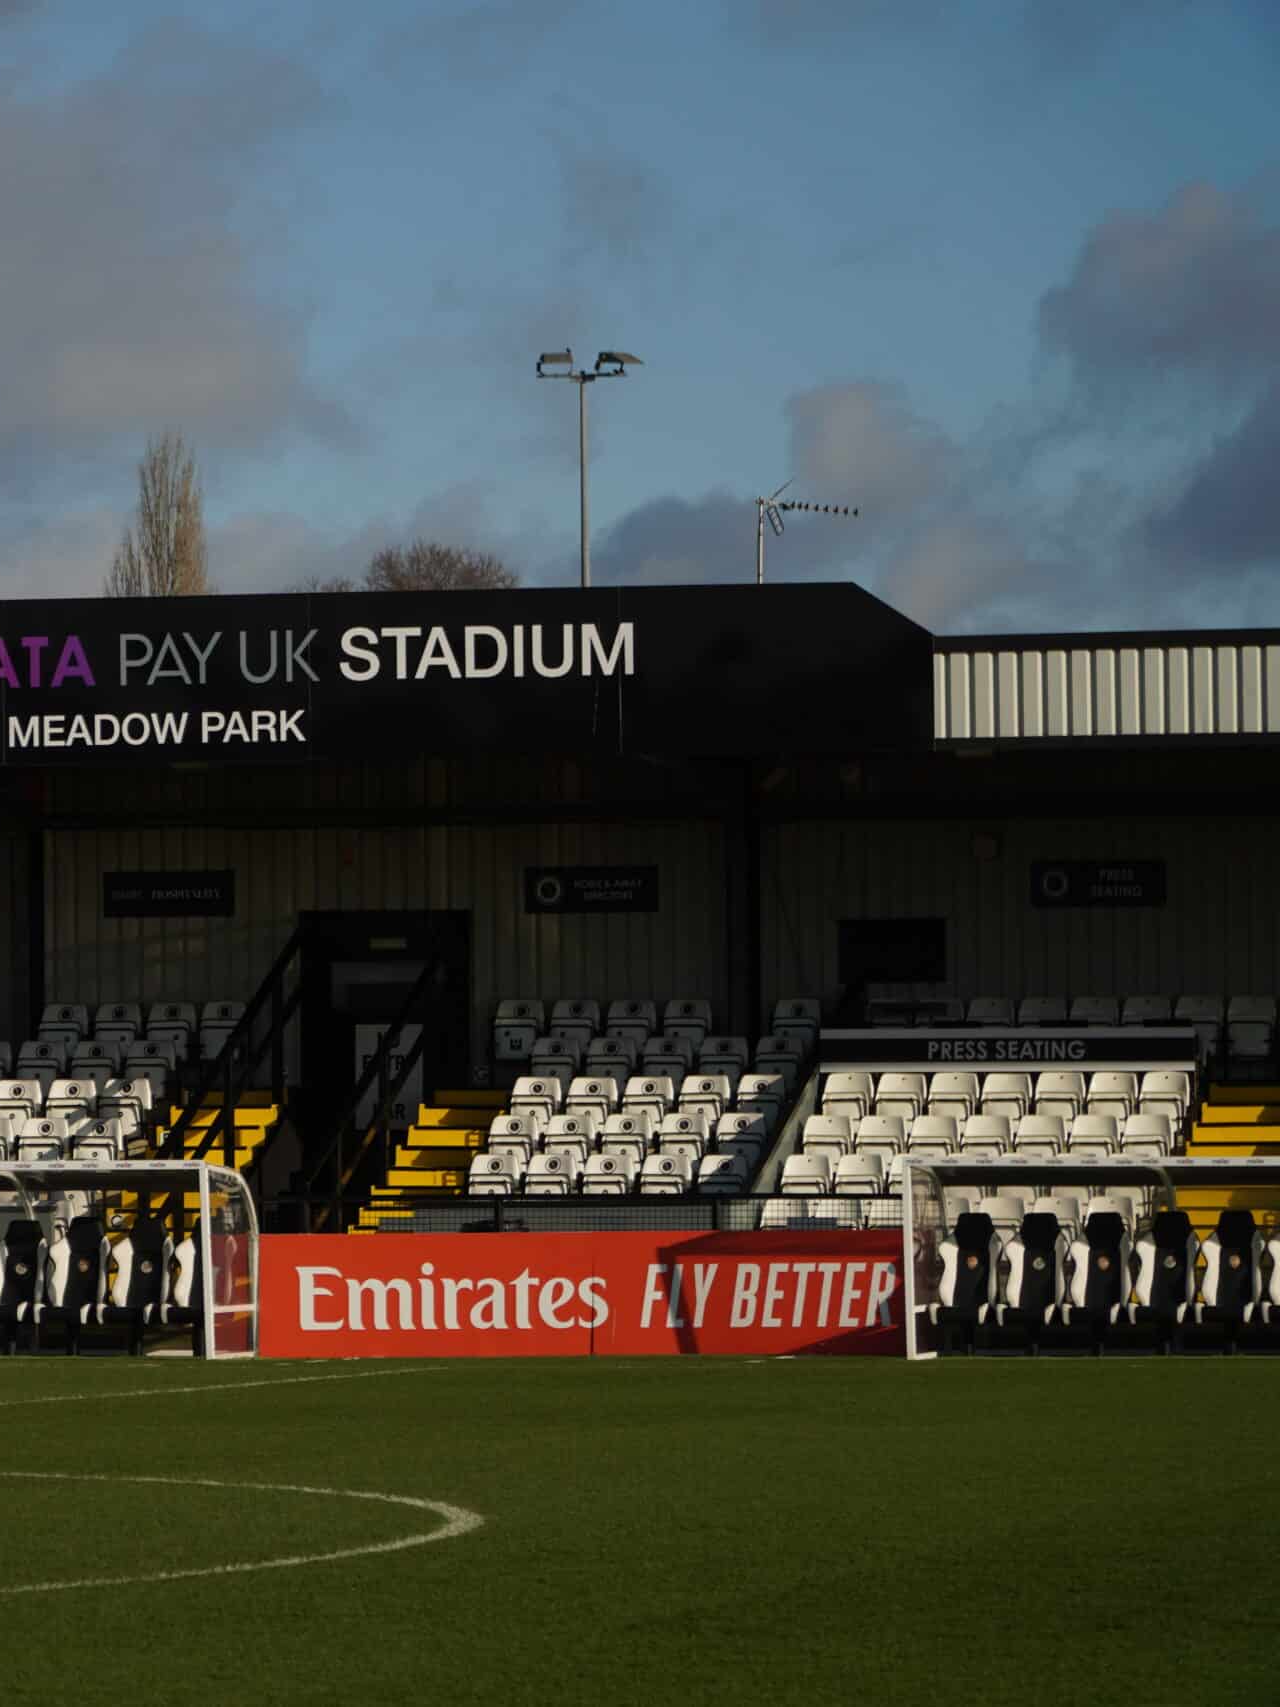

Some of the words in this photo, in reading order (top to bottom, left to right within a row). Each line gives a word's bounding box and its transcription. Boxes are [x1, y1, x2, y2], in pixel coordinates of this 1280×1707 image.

[119, 633, 222, 686] PAY
[239, 629, 319, 685] UK
[339, 621, 636, 682] STADIUM
[8, 711, 189, 748] MEADOW
[201, 709, 307, 744] PARK
[927, 1040, 988, 1060] PRESS
[994, 1040, 1087, 1060] SEATING
[294, 1261, 610, 1331] Emirates
[639, 1263, 720, 1329] FLY
[730, 1262, 897, 1328] BETTER
